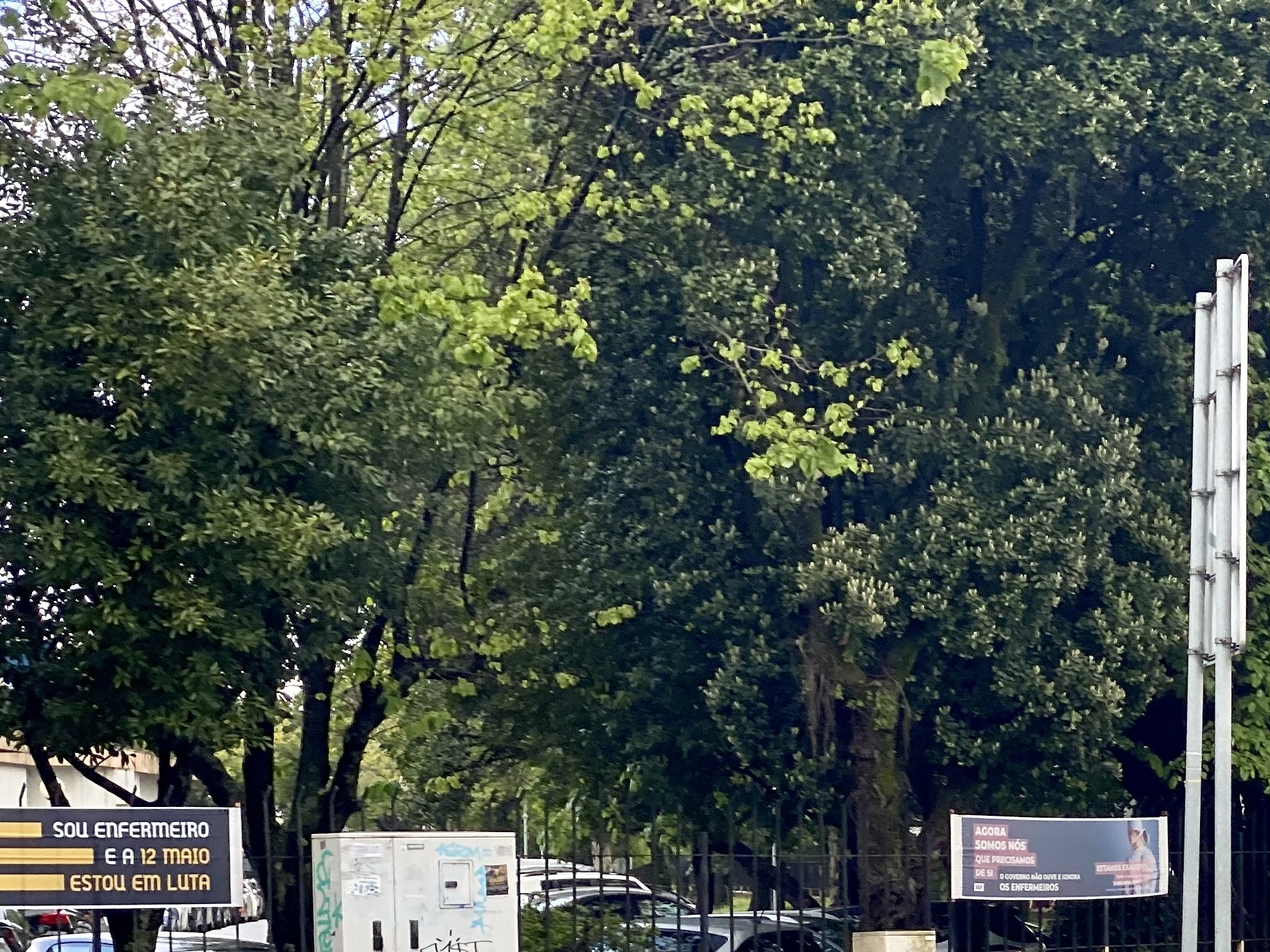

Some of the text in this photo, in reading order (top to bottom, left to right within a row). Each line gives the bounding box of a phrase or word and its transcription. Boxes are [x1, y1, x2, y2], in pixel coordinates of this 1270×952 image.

[52, 821, 210, 838] SOU ENFERMEIRO
[975, 826, 1007, 836] AGORA
[974, 838, 1026, 851] SOMOS NÓS
[105, 848, 210, 865] E A 12 MAIO
[975, 855, 1035, 865] QUE PRECISAMOS
[975, 869, 994, 877] DE SI
[70, 874, 211, 892] ESTOU EM LUTA
[999, 883, 1059, 891] OS ENFERMEIROS
